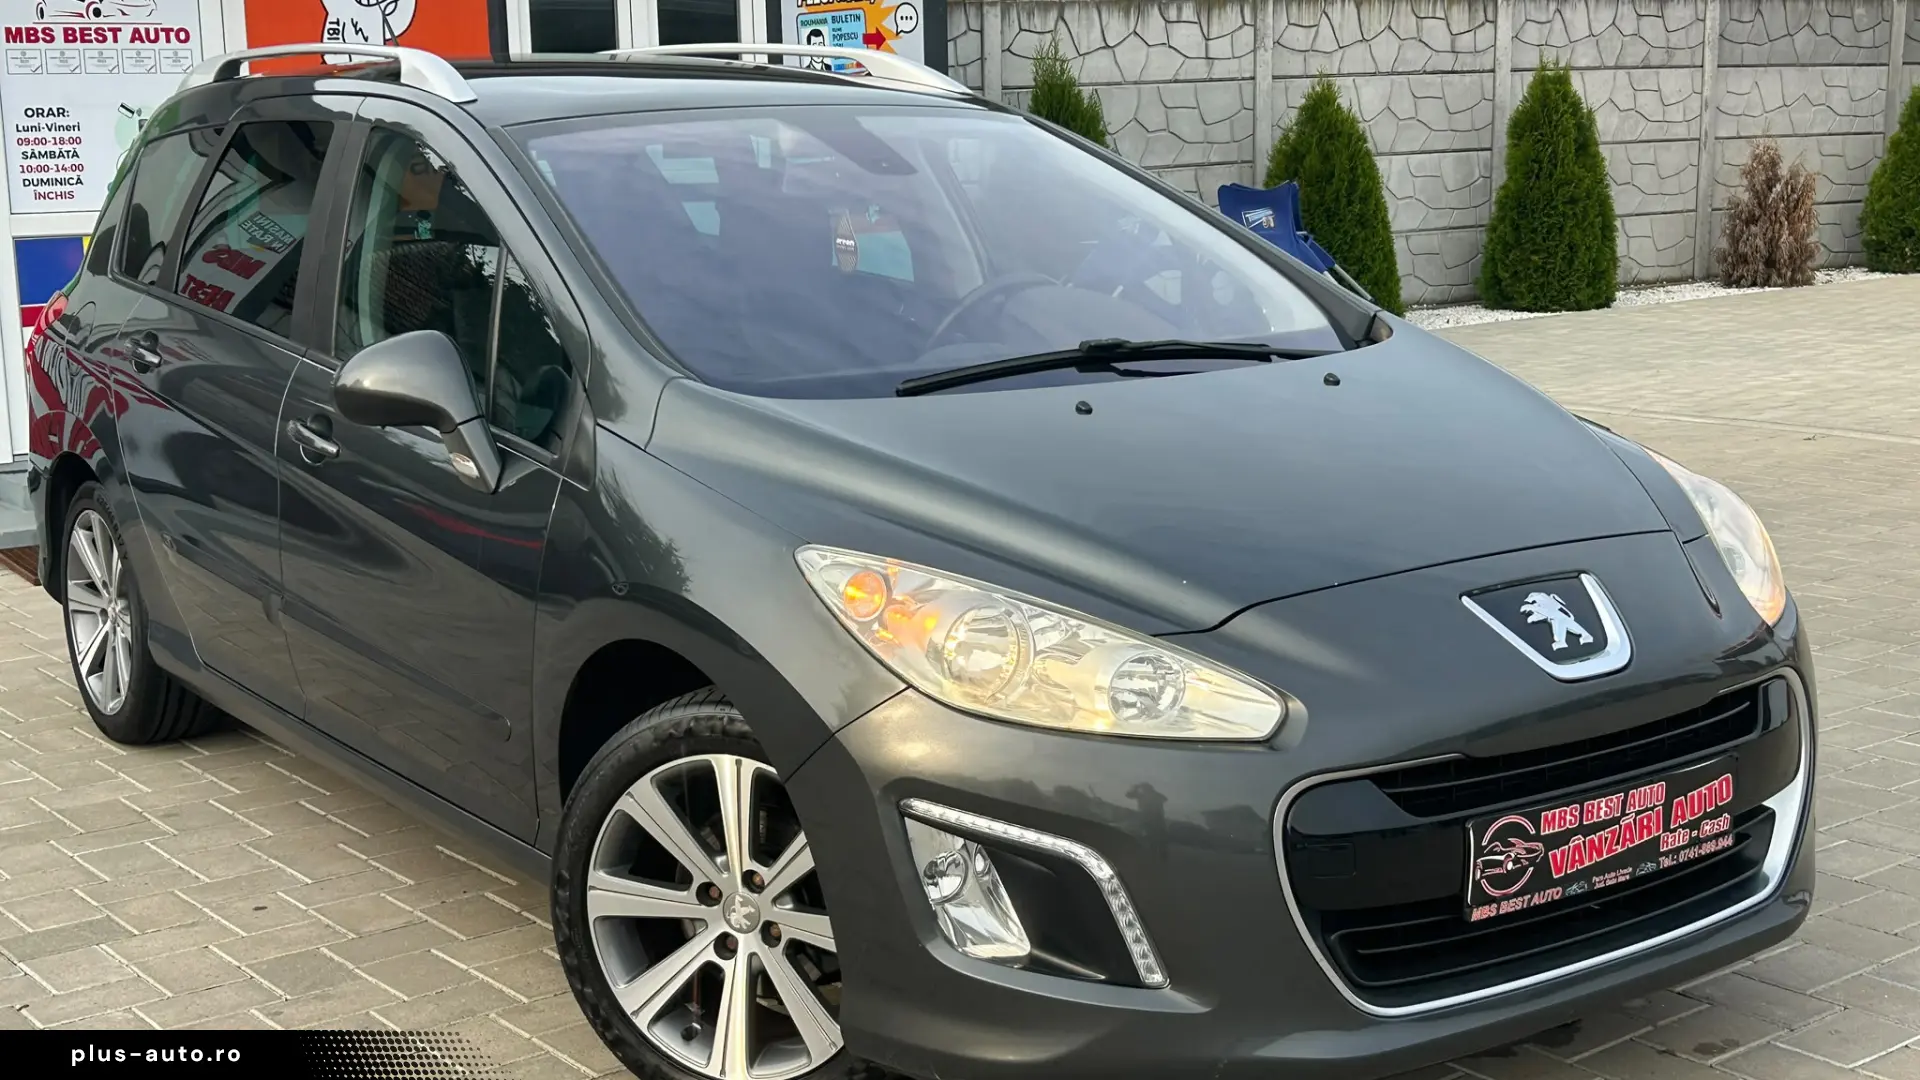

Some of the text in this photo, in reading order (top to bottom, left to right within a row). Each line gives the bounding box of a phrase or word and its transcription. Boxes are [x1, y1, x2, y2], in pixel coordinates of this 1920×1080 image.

[831, 13, 861, 24] BULETIN
[327, 18, 340, 40] TBI
[4, 27, 191, 44] MBS BEST AUTO
[832, 32, 859, 42] POPESCU
[24, 107, 70, 118] ORAR:
[16, 122, 81, 133] Luni-Vineri
[17, 136, 82, 146] 09:00-18:00
[21, 149, 80, 160] SÂMBĂTĂ
[19, 163, 84, 174] 10:00-14:00
[23, 174, 84, 187] DUMINICĂ
[34, 189, 75, 200] ÎNCHIS
[1540, 782, 1666, 835] MBS BEST AUTO
[1548, 773, 1733, 879] VÂNZĂRI AUTO
[1660, 827, 1689, 851] Rate
[1699, 813, 1731, 838] Cash
[1471, 887, 1562, 922] MBS BEST AUTO
